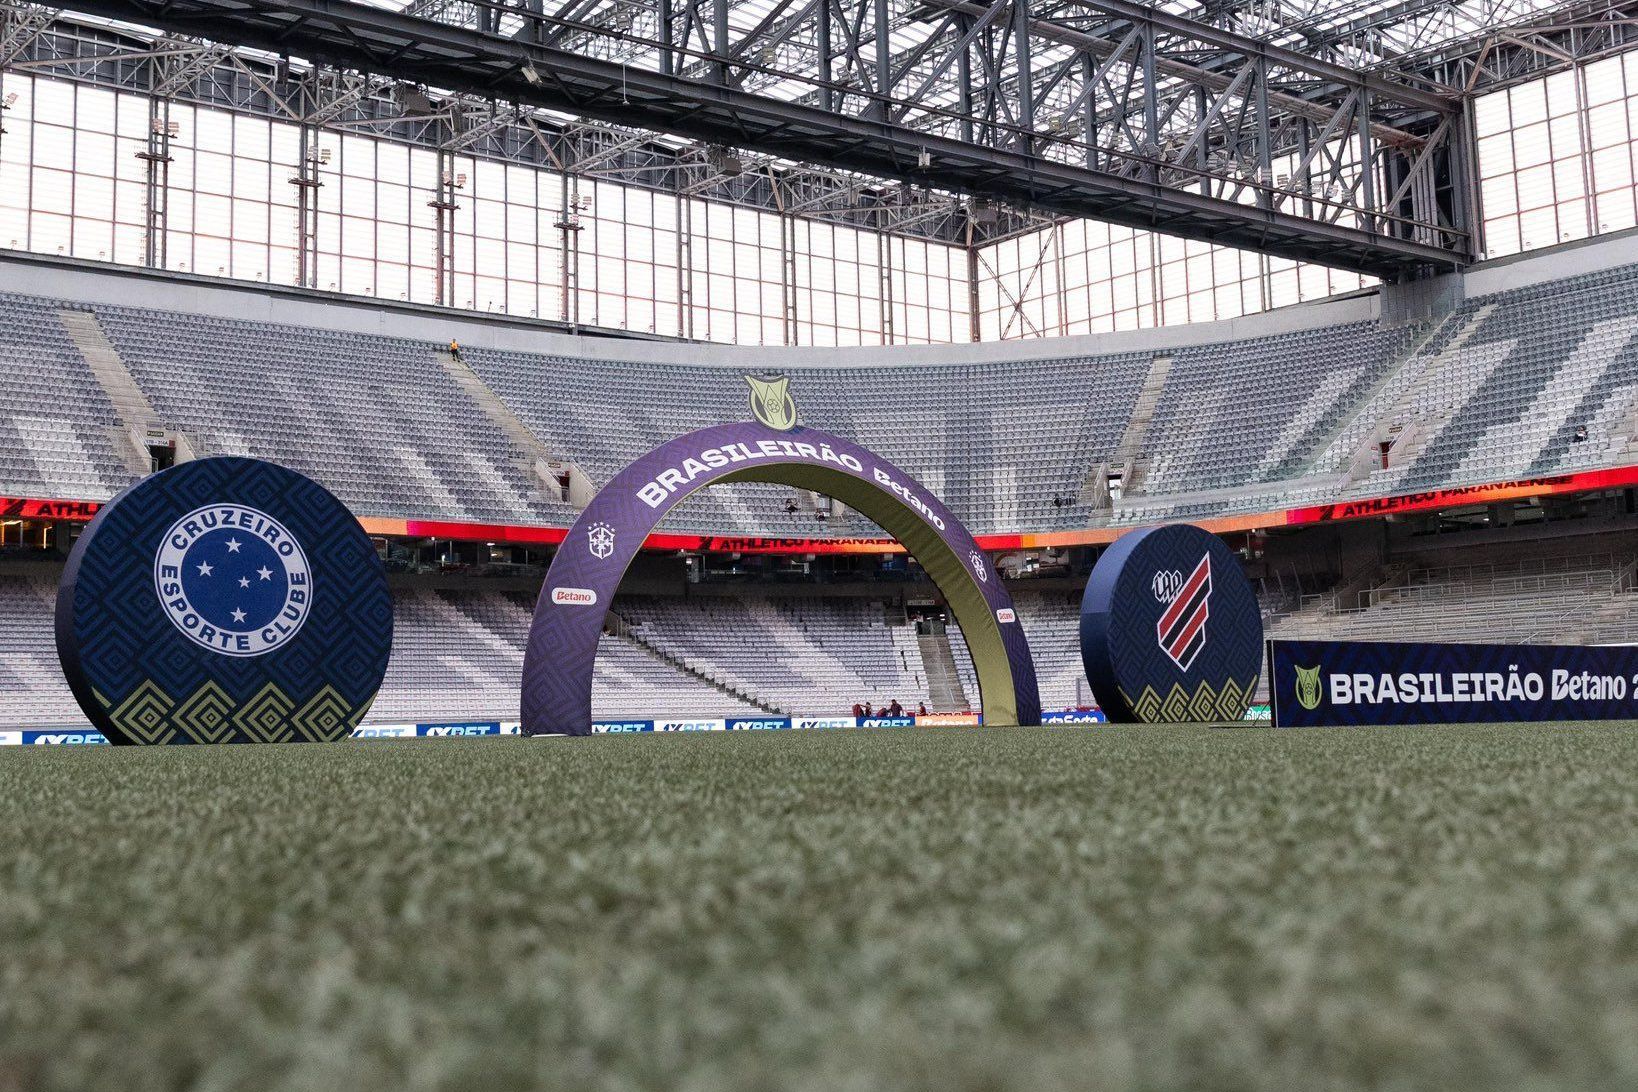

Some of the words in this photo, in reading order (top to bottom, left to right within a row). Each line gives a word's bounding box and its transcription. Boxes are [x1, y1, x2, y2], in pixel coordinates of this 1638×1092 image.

[635, 439, 864, 509] BRASILEIRÃO
[873, 466, 946, 531] Betano
[170, 509, 294, 557] CRUZEIRO
[161, 564, 251, 651] ESPORTE
[261, 572, 307, 645] CLUBE
[556, 591, 592, 602] Betano
[1329, 664, 1544, 705] BRASILEIRÃO
[1551, 668, 1627, 701] Betano
